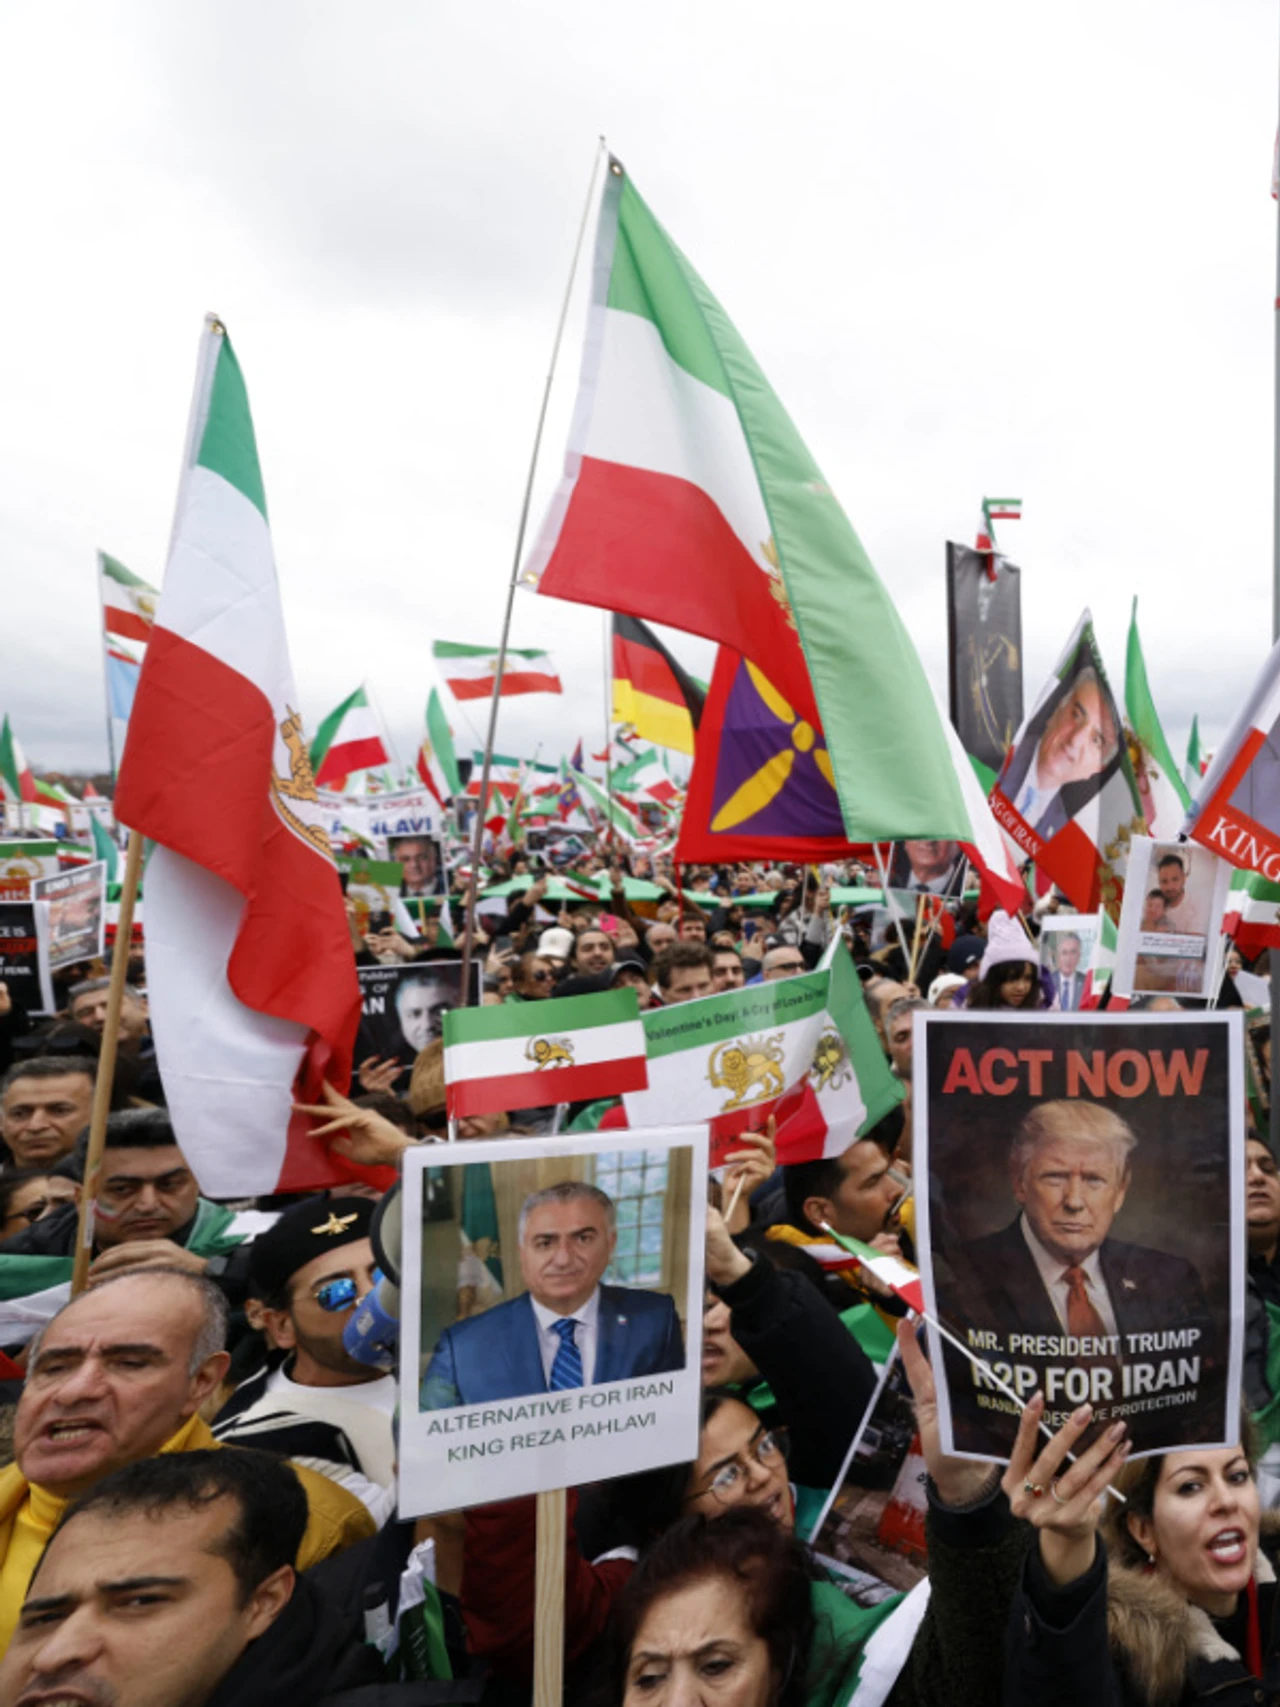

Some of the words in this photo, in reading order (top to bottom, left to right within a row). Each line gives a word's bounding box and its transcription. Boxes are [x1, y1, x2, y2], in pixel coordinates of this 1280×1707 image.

[647, 1014, 712, 1041] Valentine's
[751, 1001, 770, 1017] Cry
[942, 1047, 1053, 1096] ACT
[1066, 1048, 1208, 1098] NOW
[968, 1328, 1003, 1351] MR.
[1009, 1333, 1120, 1357] PRESIDENT
[1126, 1328, 1201, 1354] TRUMP
[970, 1358, 1038, 1397] R2P
[1044, 1366, 1114, 1403] FOR
[1121, 1355, 1201, 1397] IRAN
[427, 1397, 572, 1436] ALTERNATIVE
[578, 1391, 621, 1411] FOR
[626, 1380, 674, 1401] IRAN
[1043, 1407, 1108, 1427] DESVE
[1111, 1390, 1198, 1418] PROTECTION
[447, 1439, 505, 1463] KING
[510, 1428, 565, 1451] REZA
[571, 1411, 656, 1441] PAHLAVI
